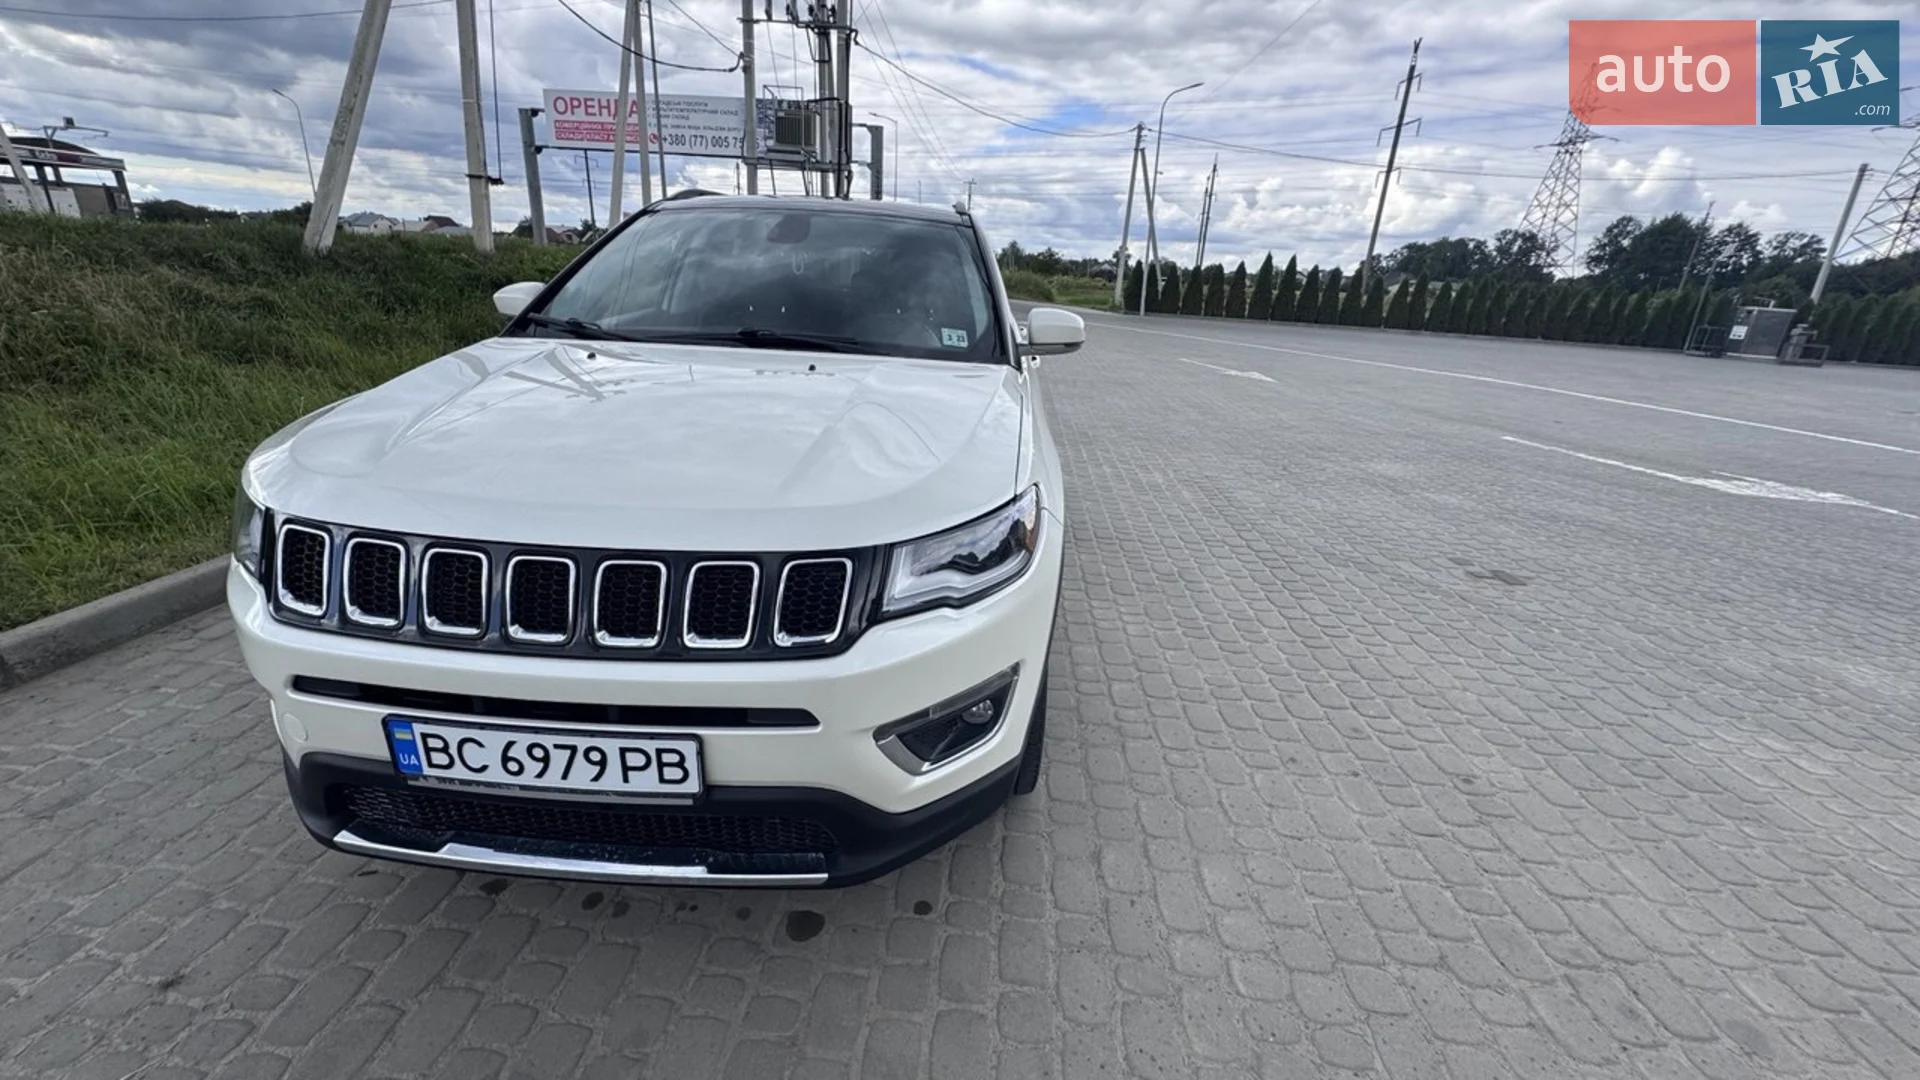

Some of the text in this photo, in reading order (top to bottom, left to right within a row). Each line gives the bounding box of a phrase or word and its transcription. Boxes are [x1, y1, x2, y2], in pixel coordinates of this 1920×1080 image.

[662, 133, 687, 147] +380
[689, 135, 709, 150] (77)
[711, 136, 730, 148] 005
[400, 753, 420, 766] UA
[420, 731, 691, 785] BC 6979 PB
